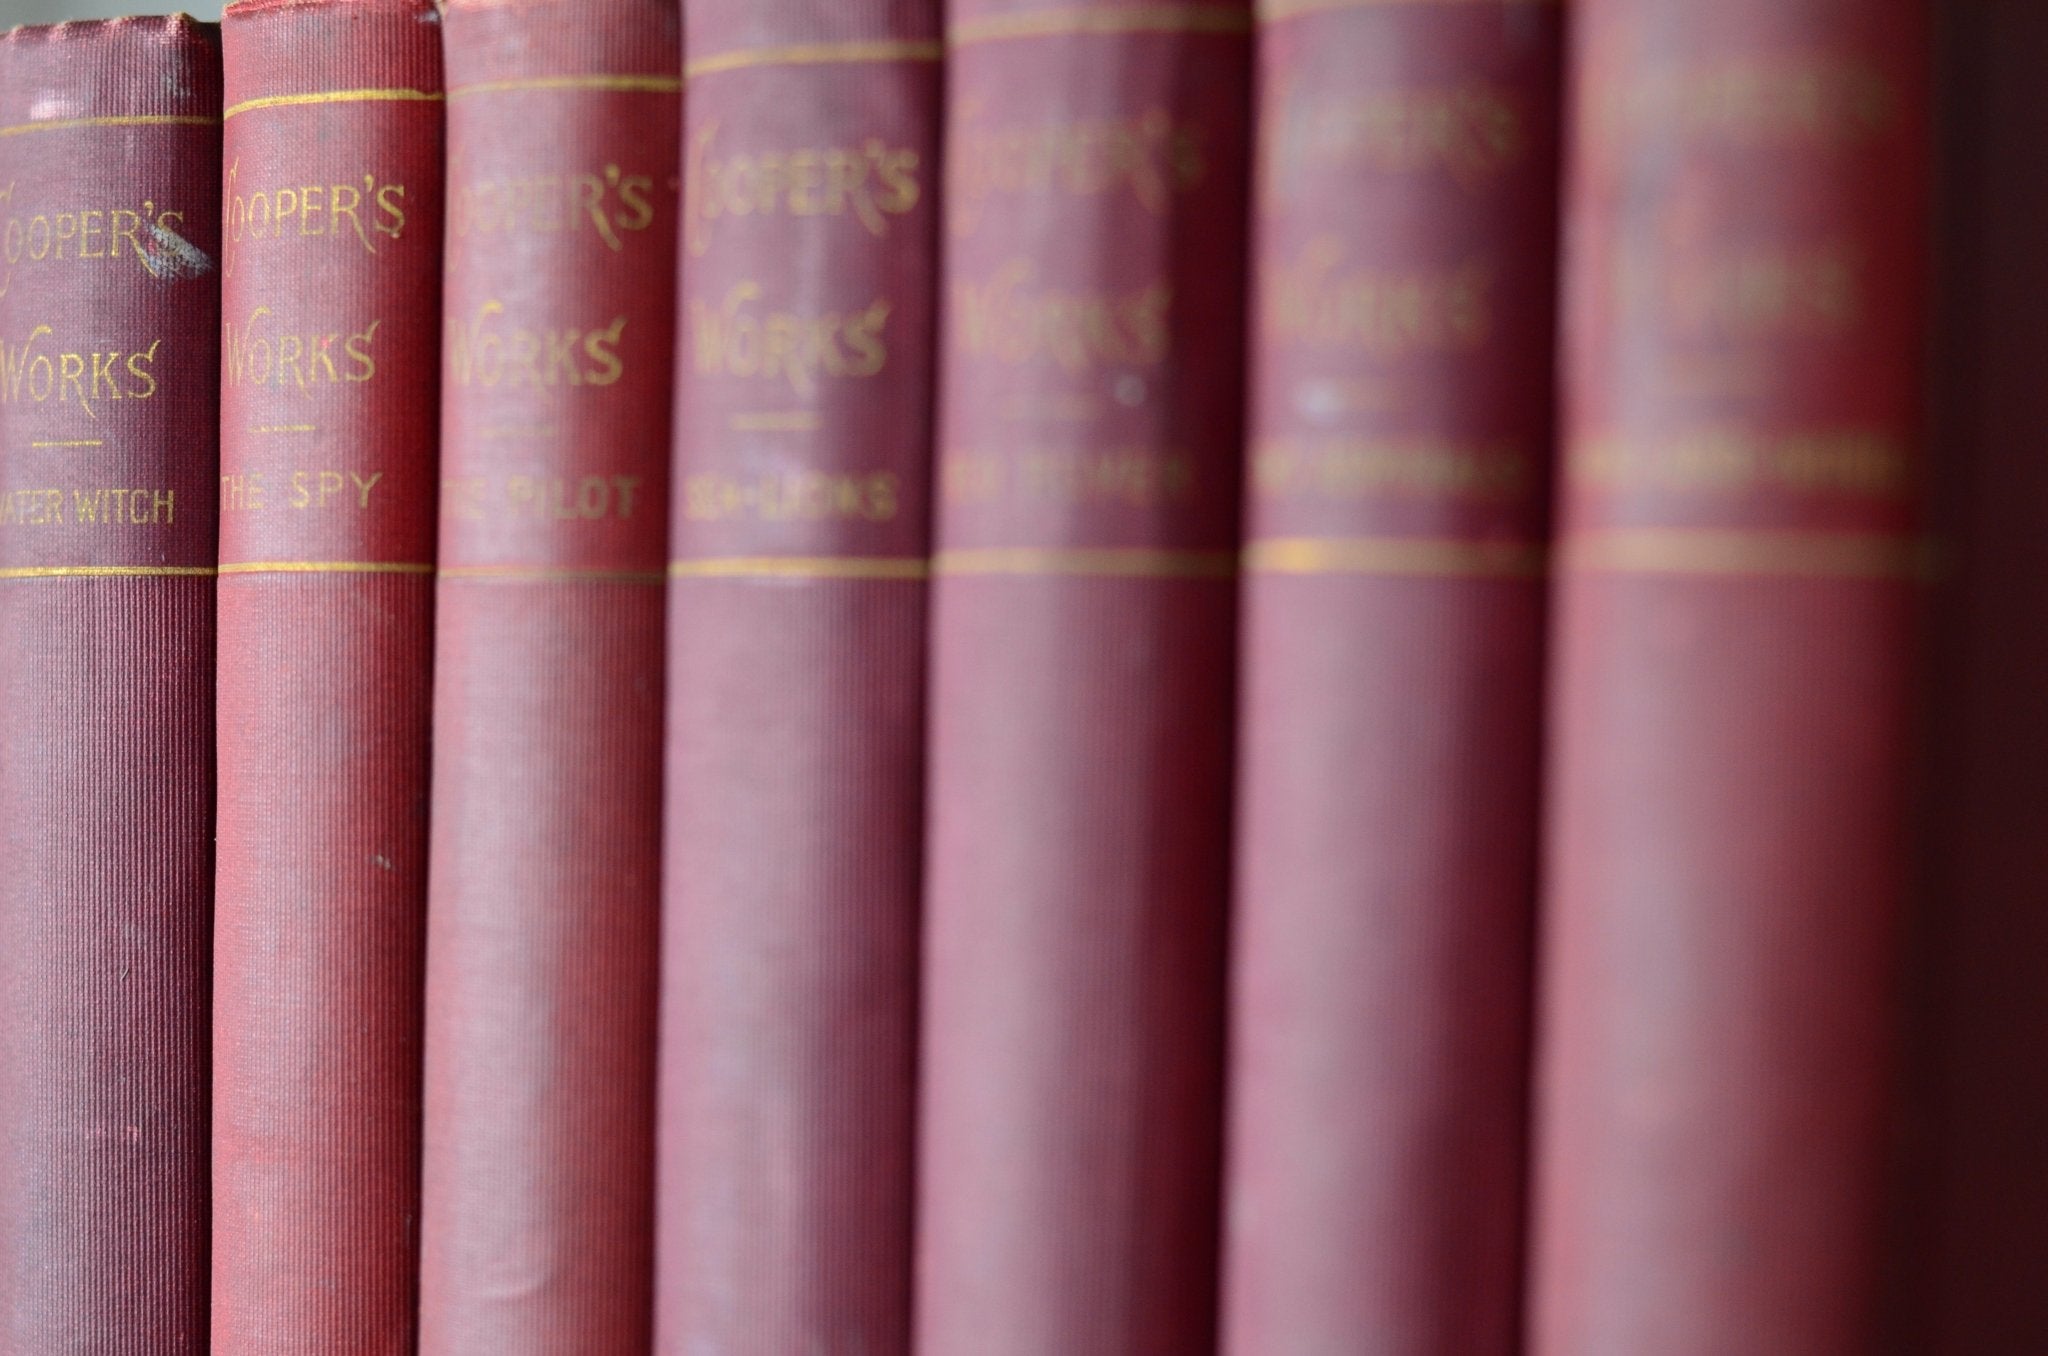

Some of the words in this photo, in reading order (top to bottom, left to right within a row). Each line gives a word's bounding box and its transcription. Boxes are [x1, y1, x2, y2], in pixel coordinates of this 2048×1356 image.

[225, 156, 405, 278] COOPER'S
[0, 325, 161, 419] WORKS
[226, 305, 381, 397] WORKS
[0, 489, 65, 525] ATER
[73, 488, 175, 525] WITCH
[221, 472, 264, 511] THE
[289, 470, 384, 510] SPY
